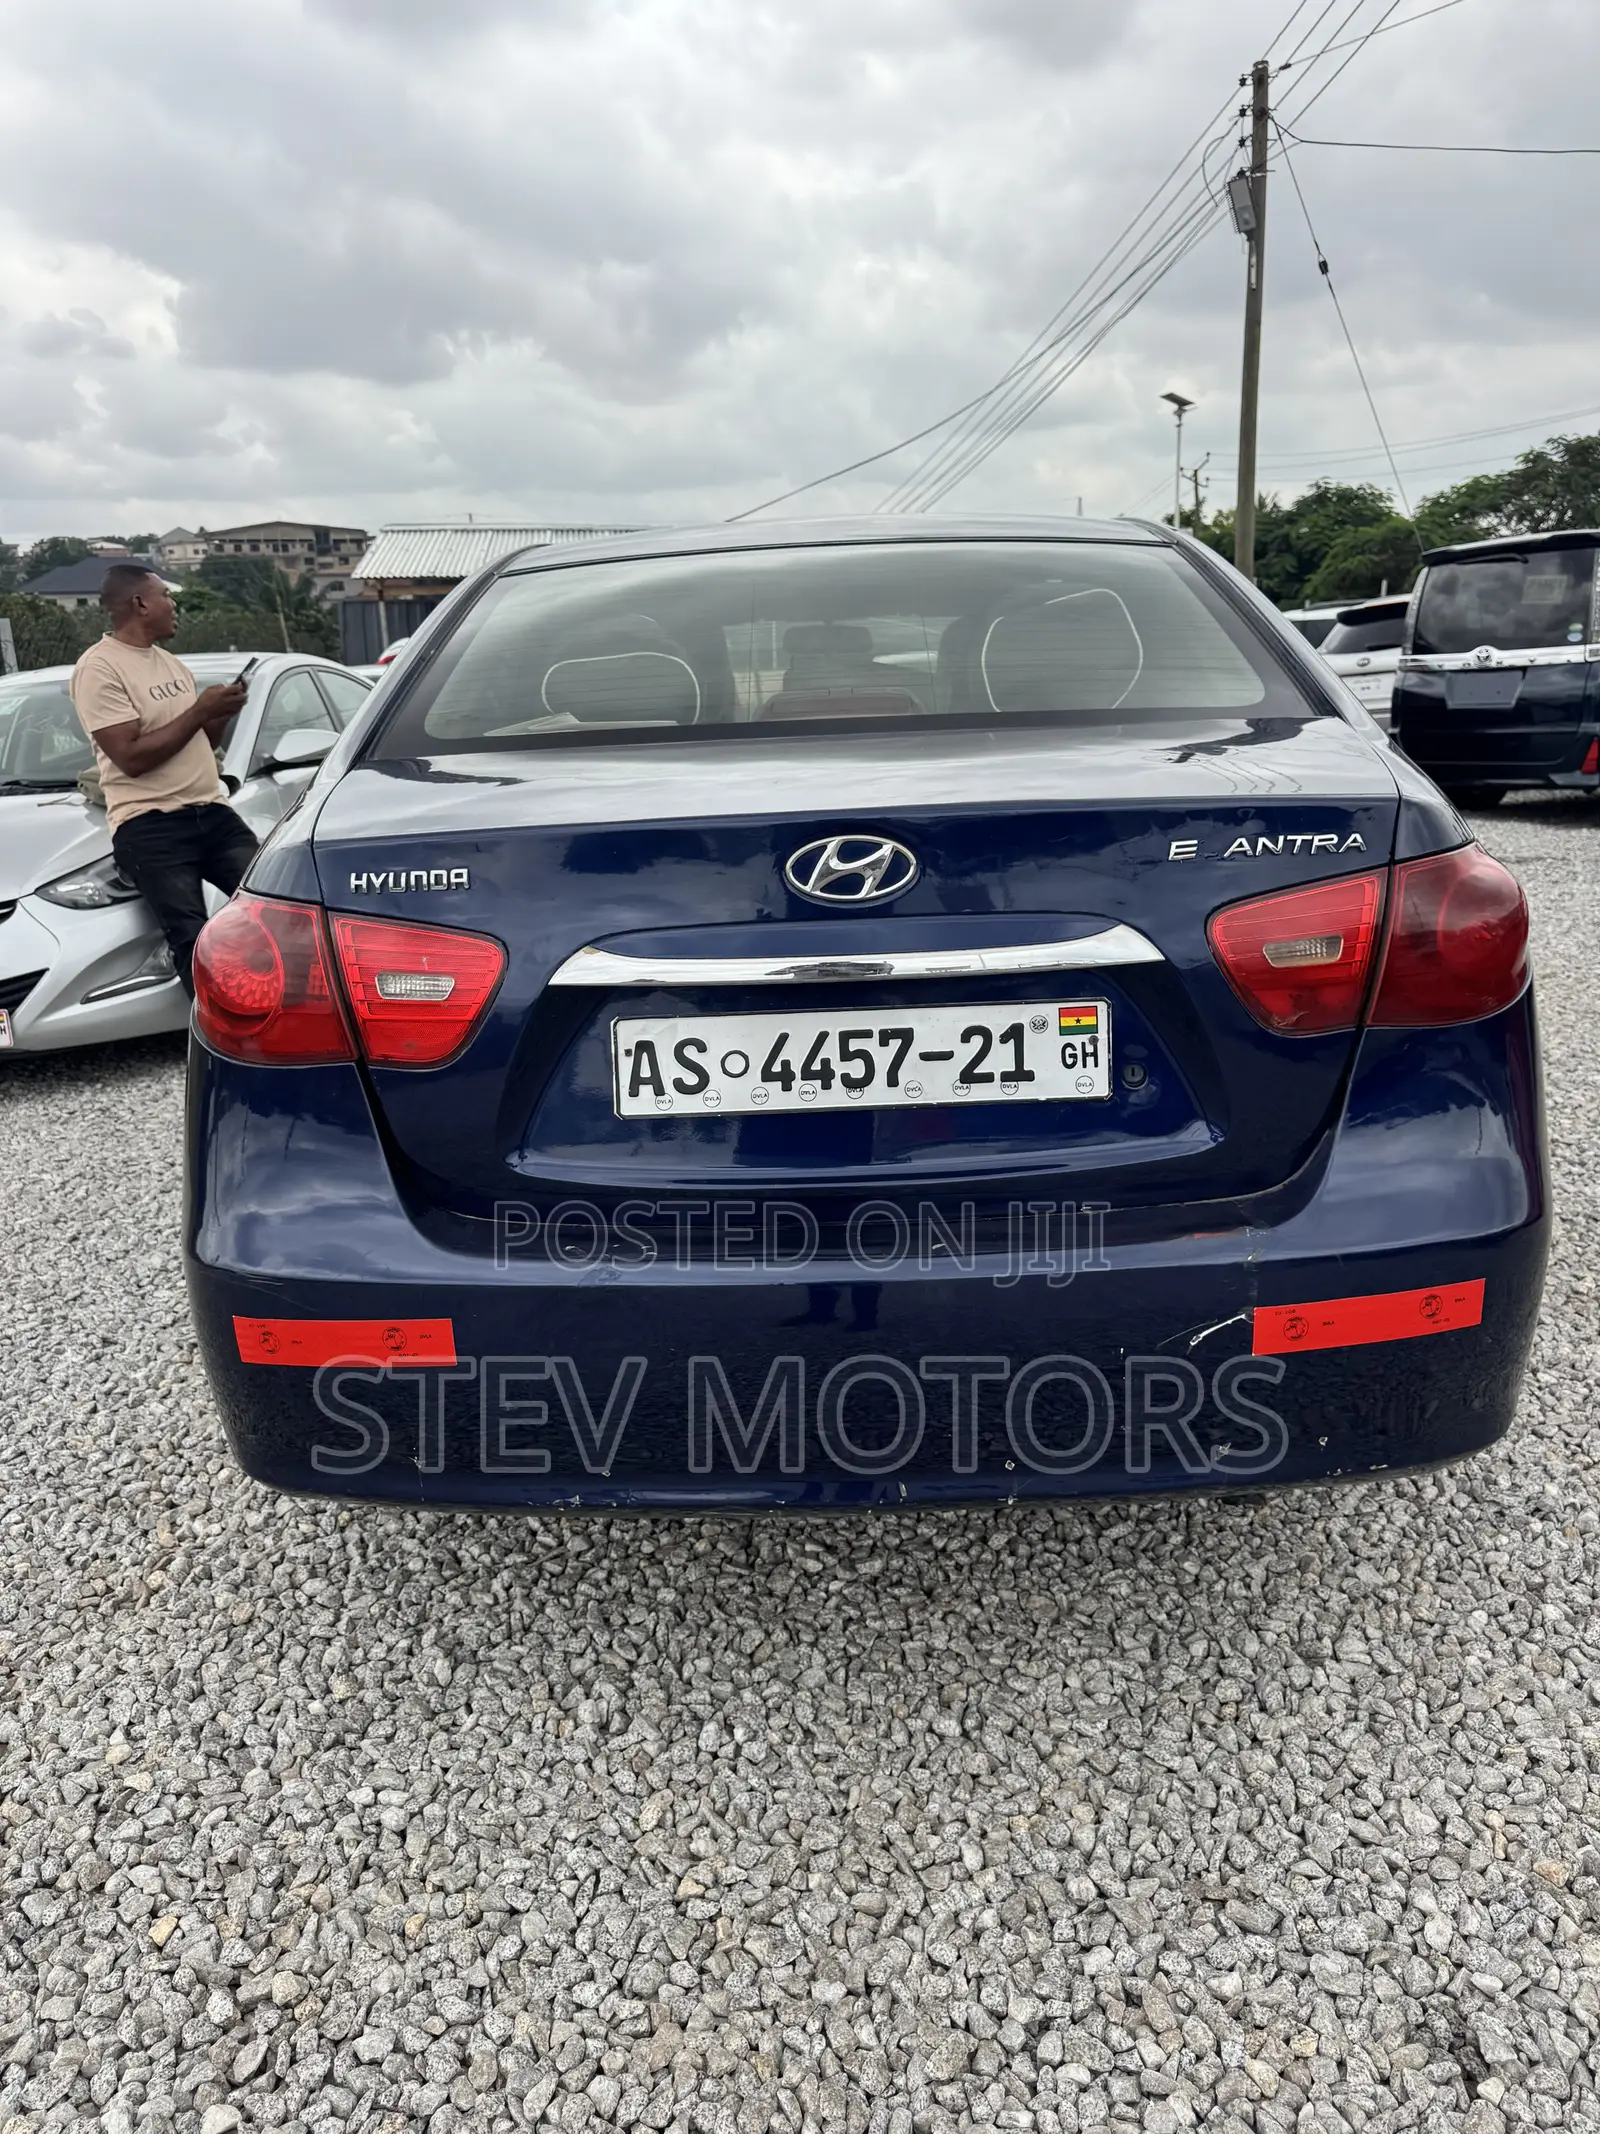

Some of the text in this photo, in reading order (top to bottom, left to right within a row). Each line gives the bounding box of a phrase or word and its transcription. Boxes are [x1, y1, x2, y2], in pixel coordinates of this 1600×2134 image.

[627, 1022, 1036, 1098] AS 4457-21
[1060, 1041, 1100, 1069] GH
